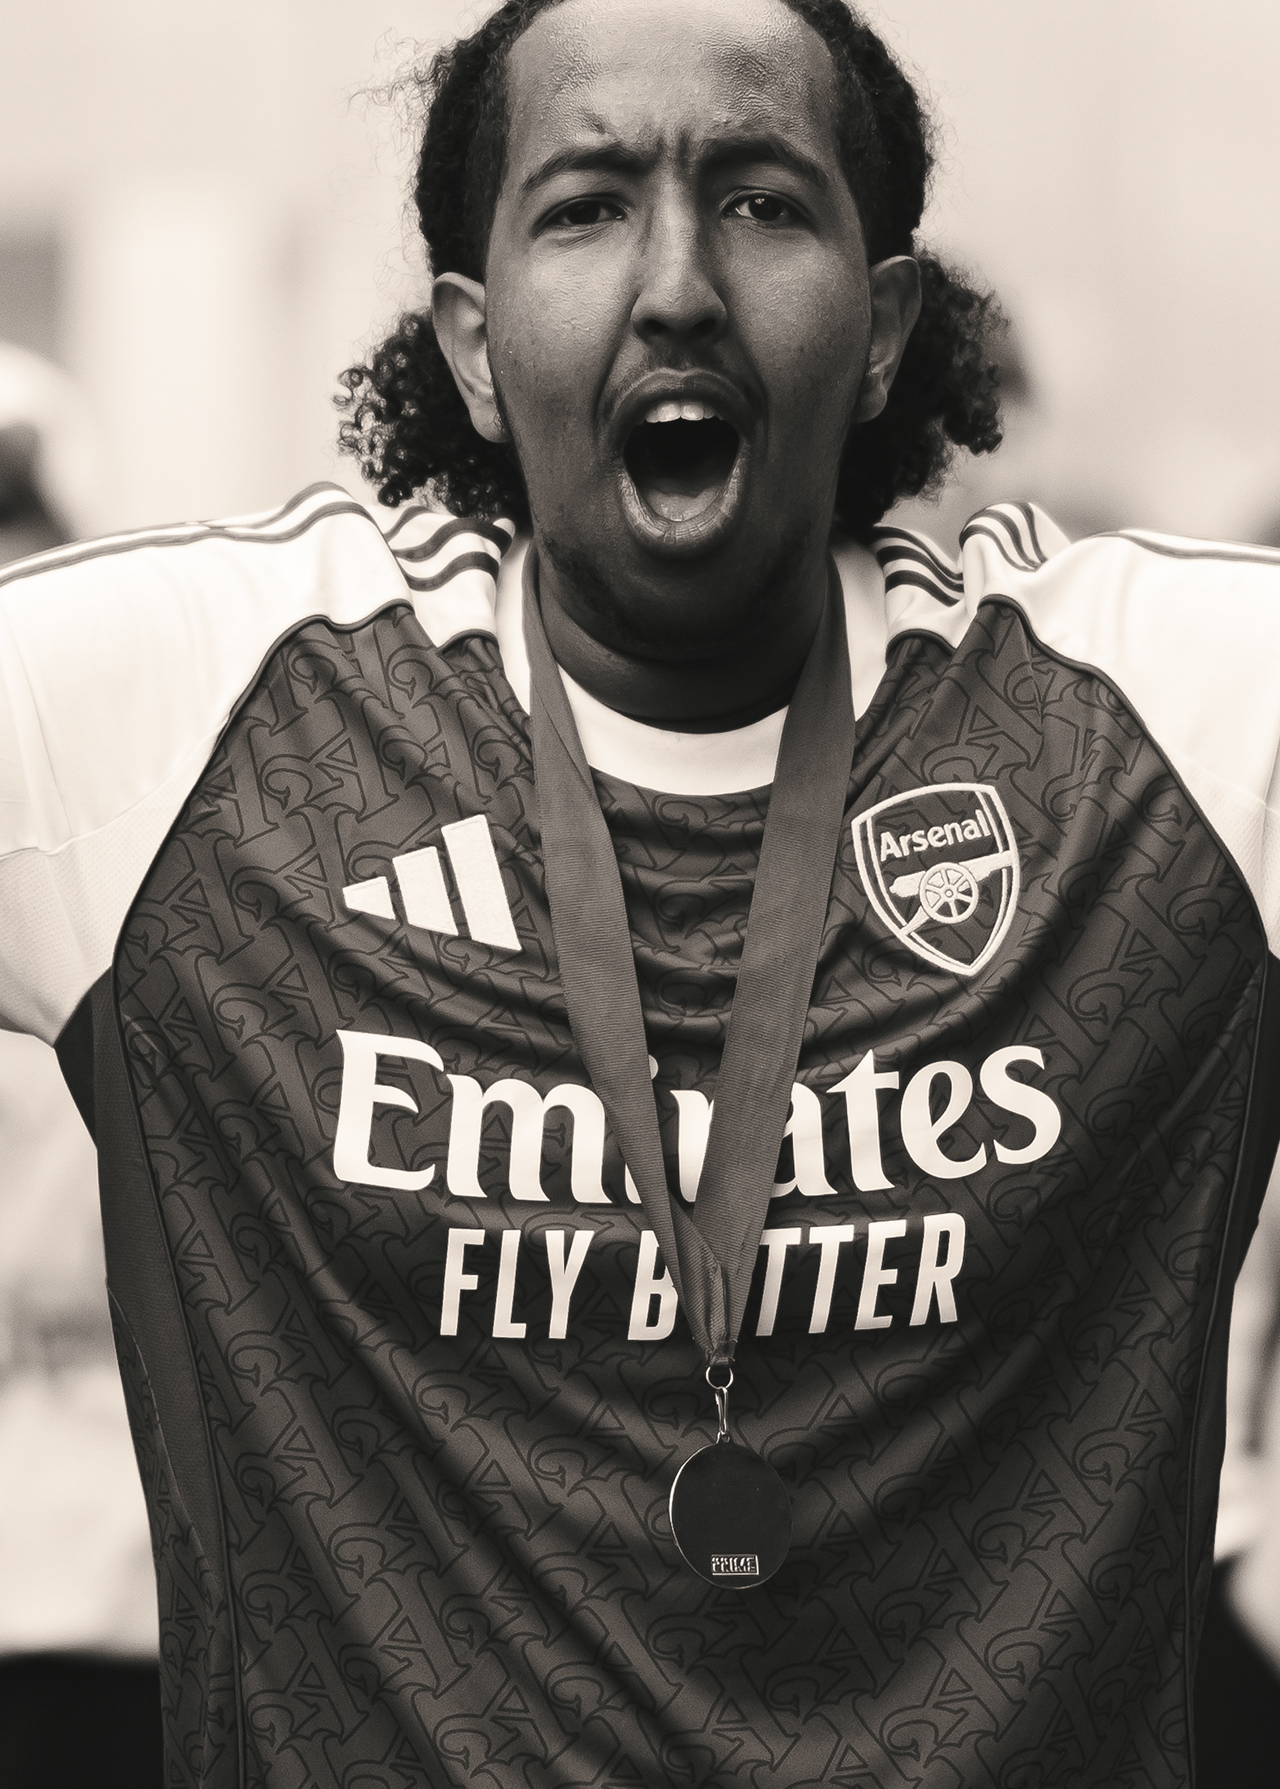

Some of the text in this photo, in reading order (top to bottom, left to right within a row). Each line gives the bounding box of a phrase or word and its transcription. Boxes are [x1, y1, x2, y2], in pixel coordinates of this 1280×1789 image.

[880, 809, 991, 862] Arsenal
[333, 1028, 1062, 1205] Emrates
[440, 1212, 967, 1342] FLY BTTER
